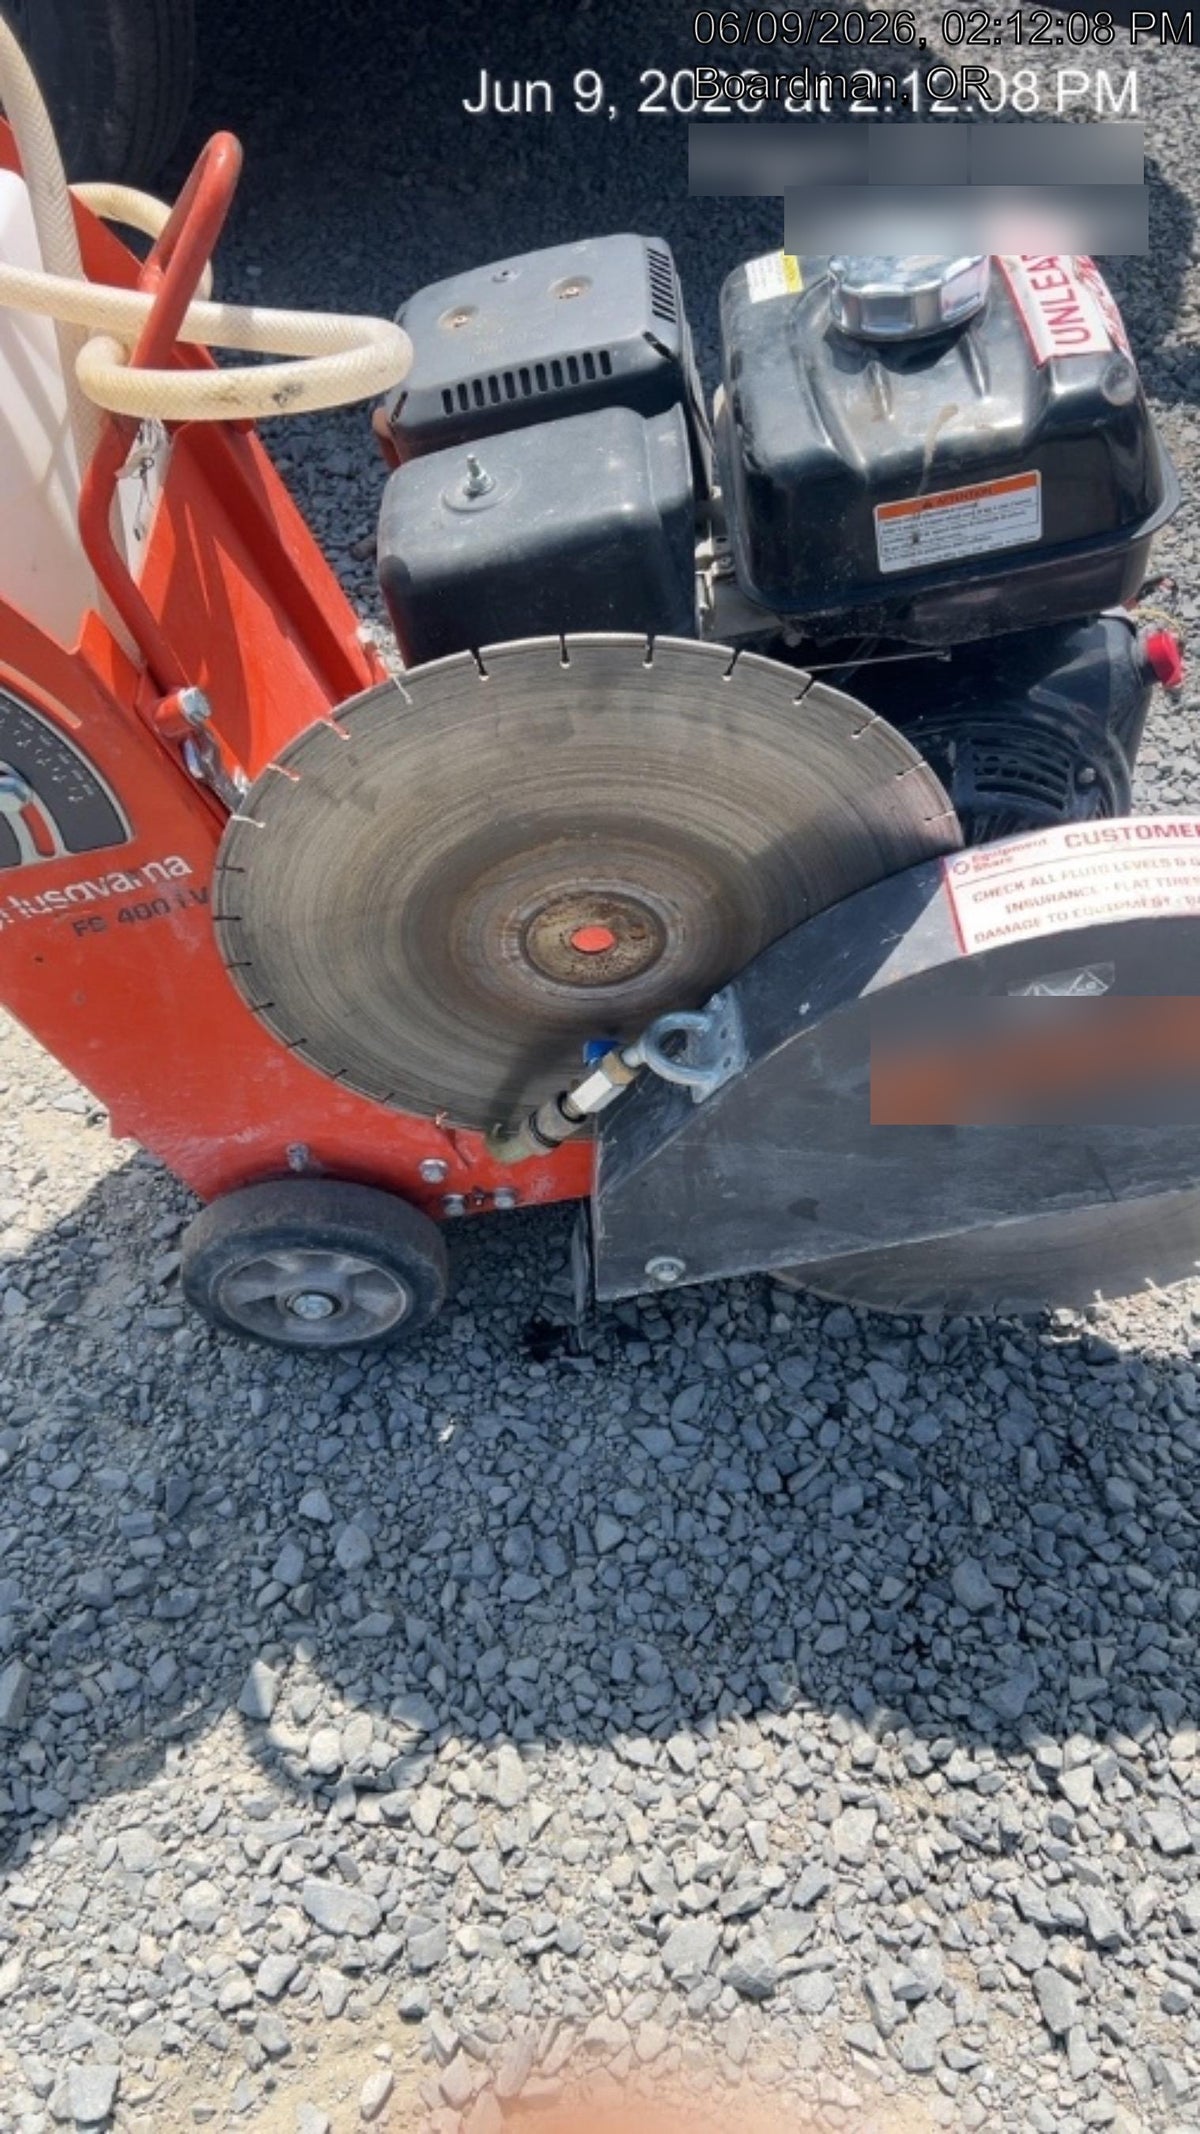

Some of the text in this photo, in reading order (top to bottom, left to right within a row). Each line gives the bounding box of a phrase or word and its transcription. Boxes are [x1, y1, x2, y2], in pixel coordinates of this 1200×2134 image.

[972, 838, 1048, 863] Equipment
[972, 880, 1025, 903] CHECK
[1030, 873, 1057, 888] ALL
[1062, 862, 1110, 881] FLUID
[1114, 857, 1171, 874] LEVELS
[1005, 885, 1097, 914] INSURANCE
[1114, 878, 1150, 893] FLAT
[118, 897, 171, 924] 400
[974, 916, 1041, 944] DAMAGE
[1048, 910, 1069, 924] TO
[1073, 895, 1170, 919] EQUIPMENT
